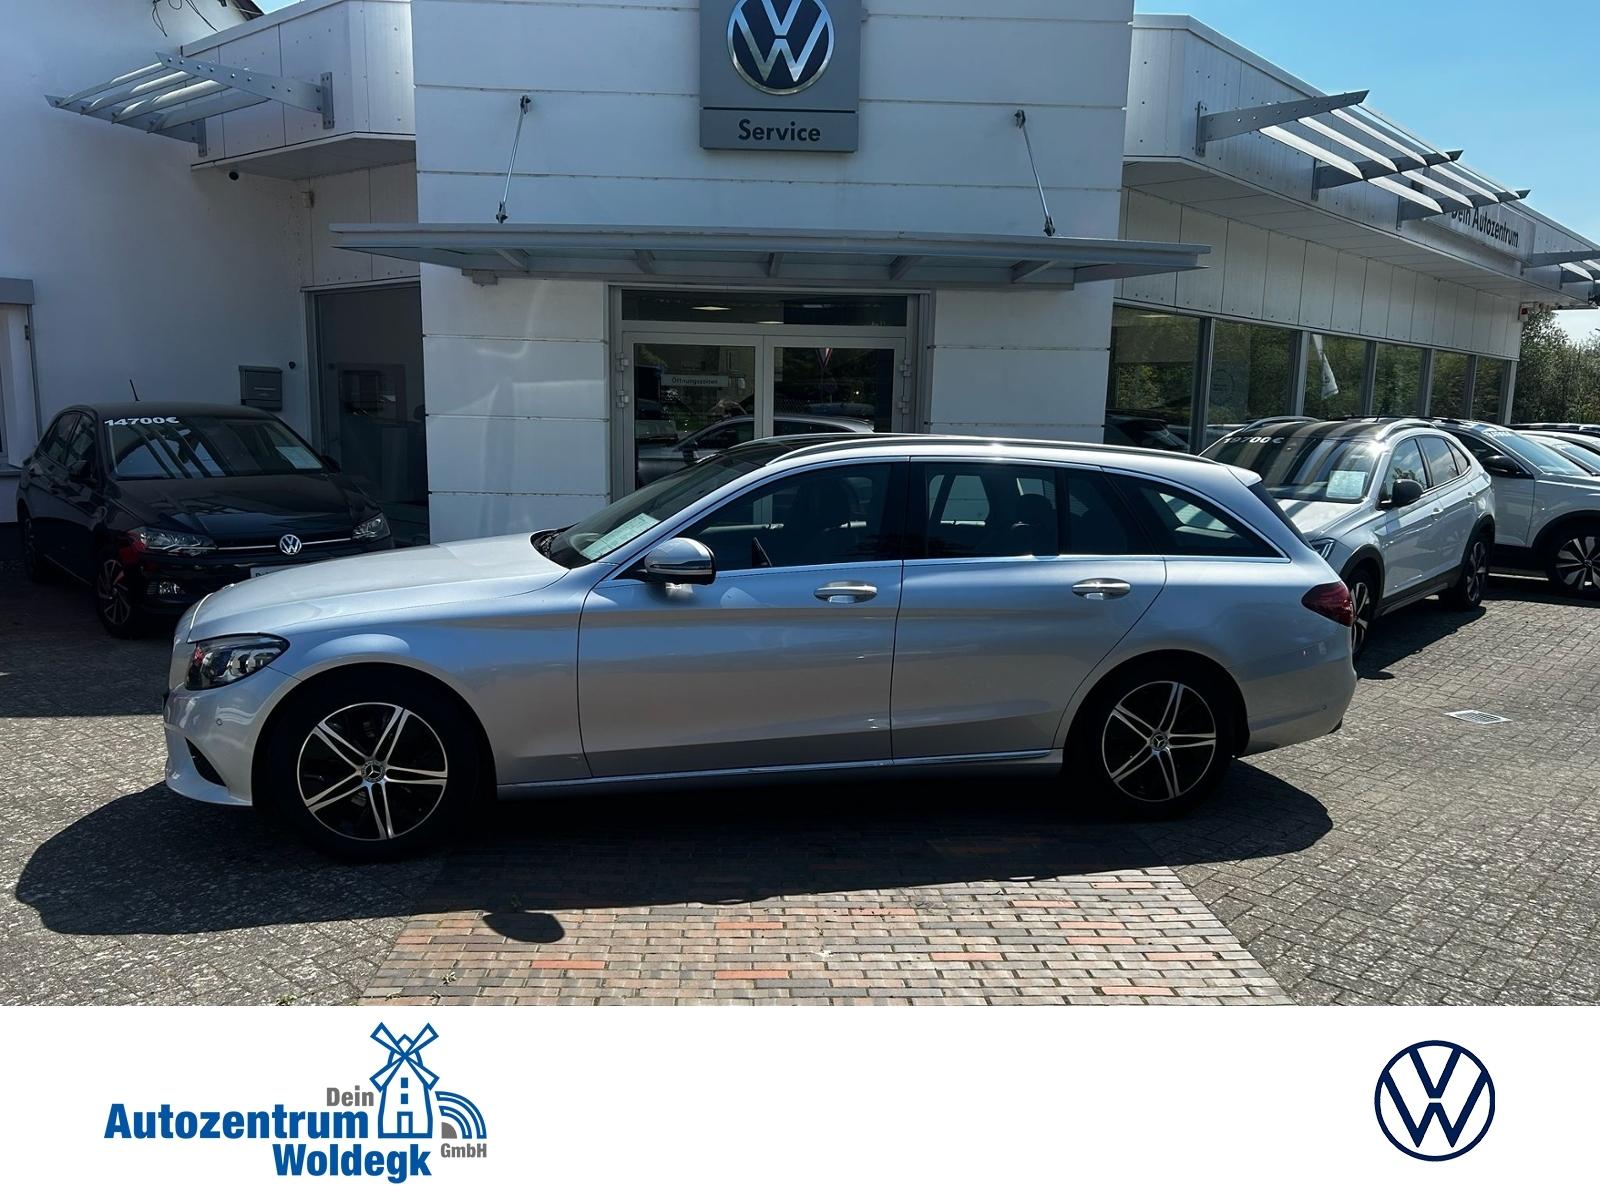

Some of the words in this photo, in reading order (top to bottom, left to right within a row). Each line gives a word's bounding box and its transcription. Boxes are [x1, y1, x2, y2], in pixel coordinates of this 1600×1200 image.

[738, 118, 821, 142] Service
[1471, 206, 1519, 249] Autozentrum
[104, 416, 180, 426] 14700€
